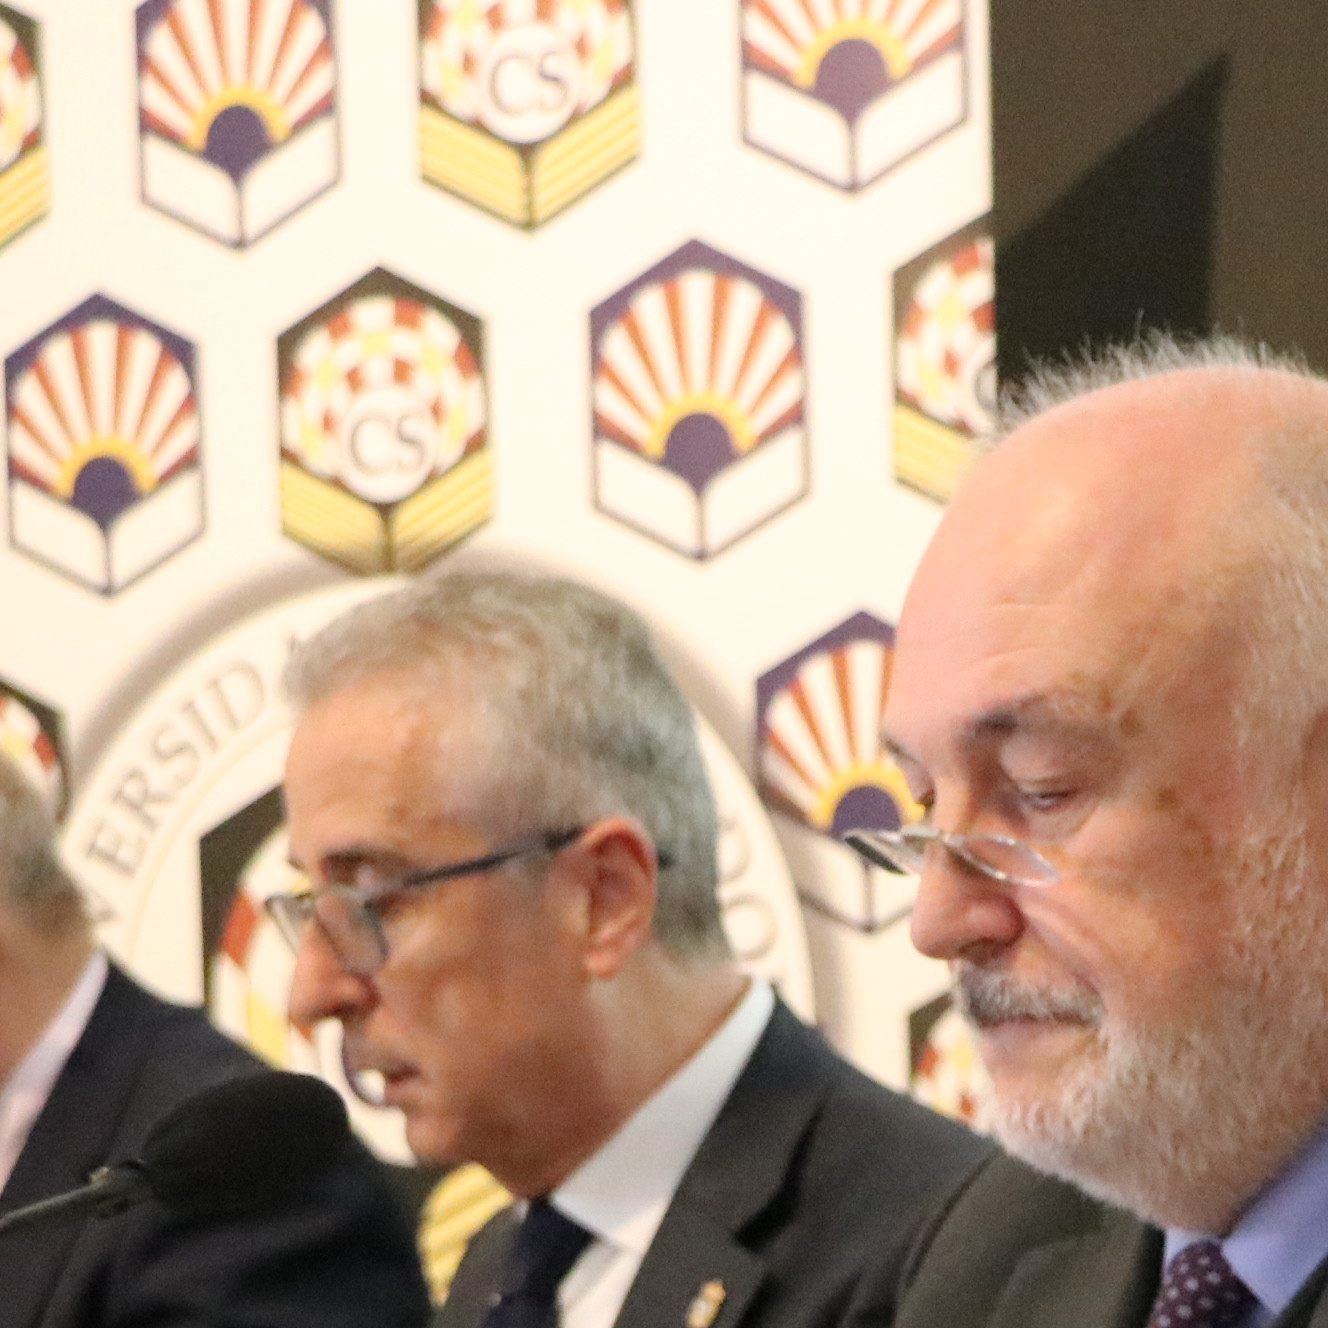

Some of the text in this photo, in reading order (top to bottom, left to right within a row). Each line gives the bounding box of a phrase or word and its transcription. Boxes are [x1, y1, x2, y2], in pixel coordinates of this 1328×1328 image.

[489, 49, 571, 116] CS
[350, 407, 429, 469] CS
[84, 645, 278, 900] ERSID
